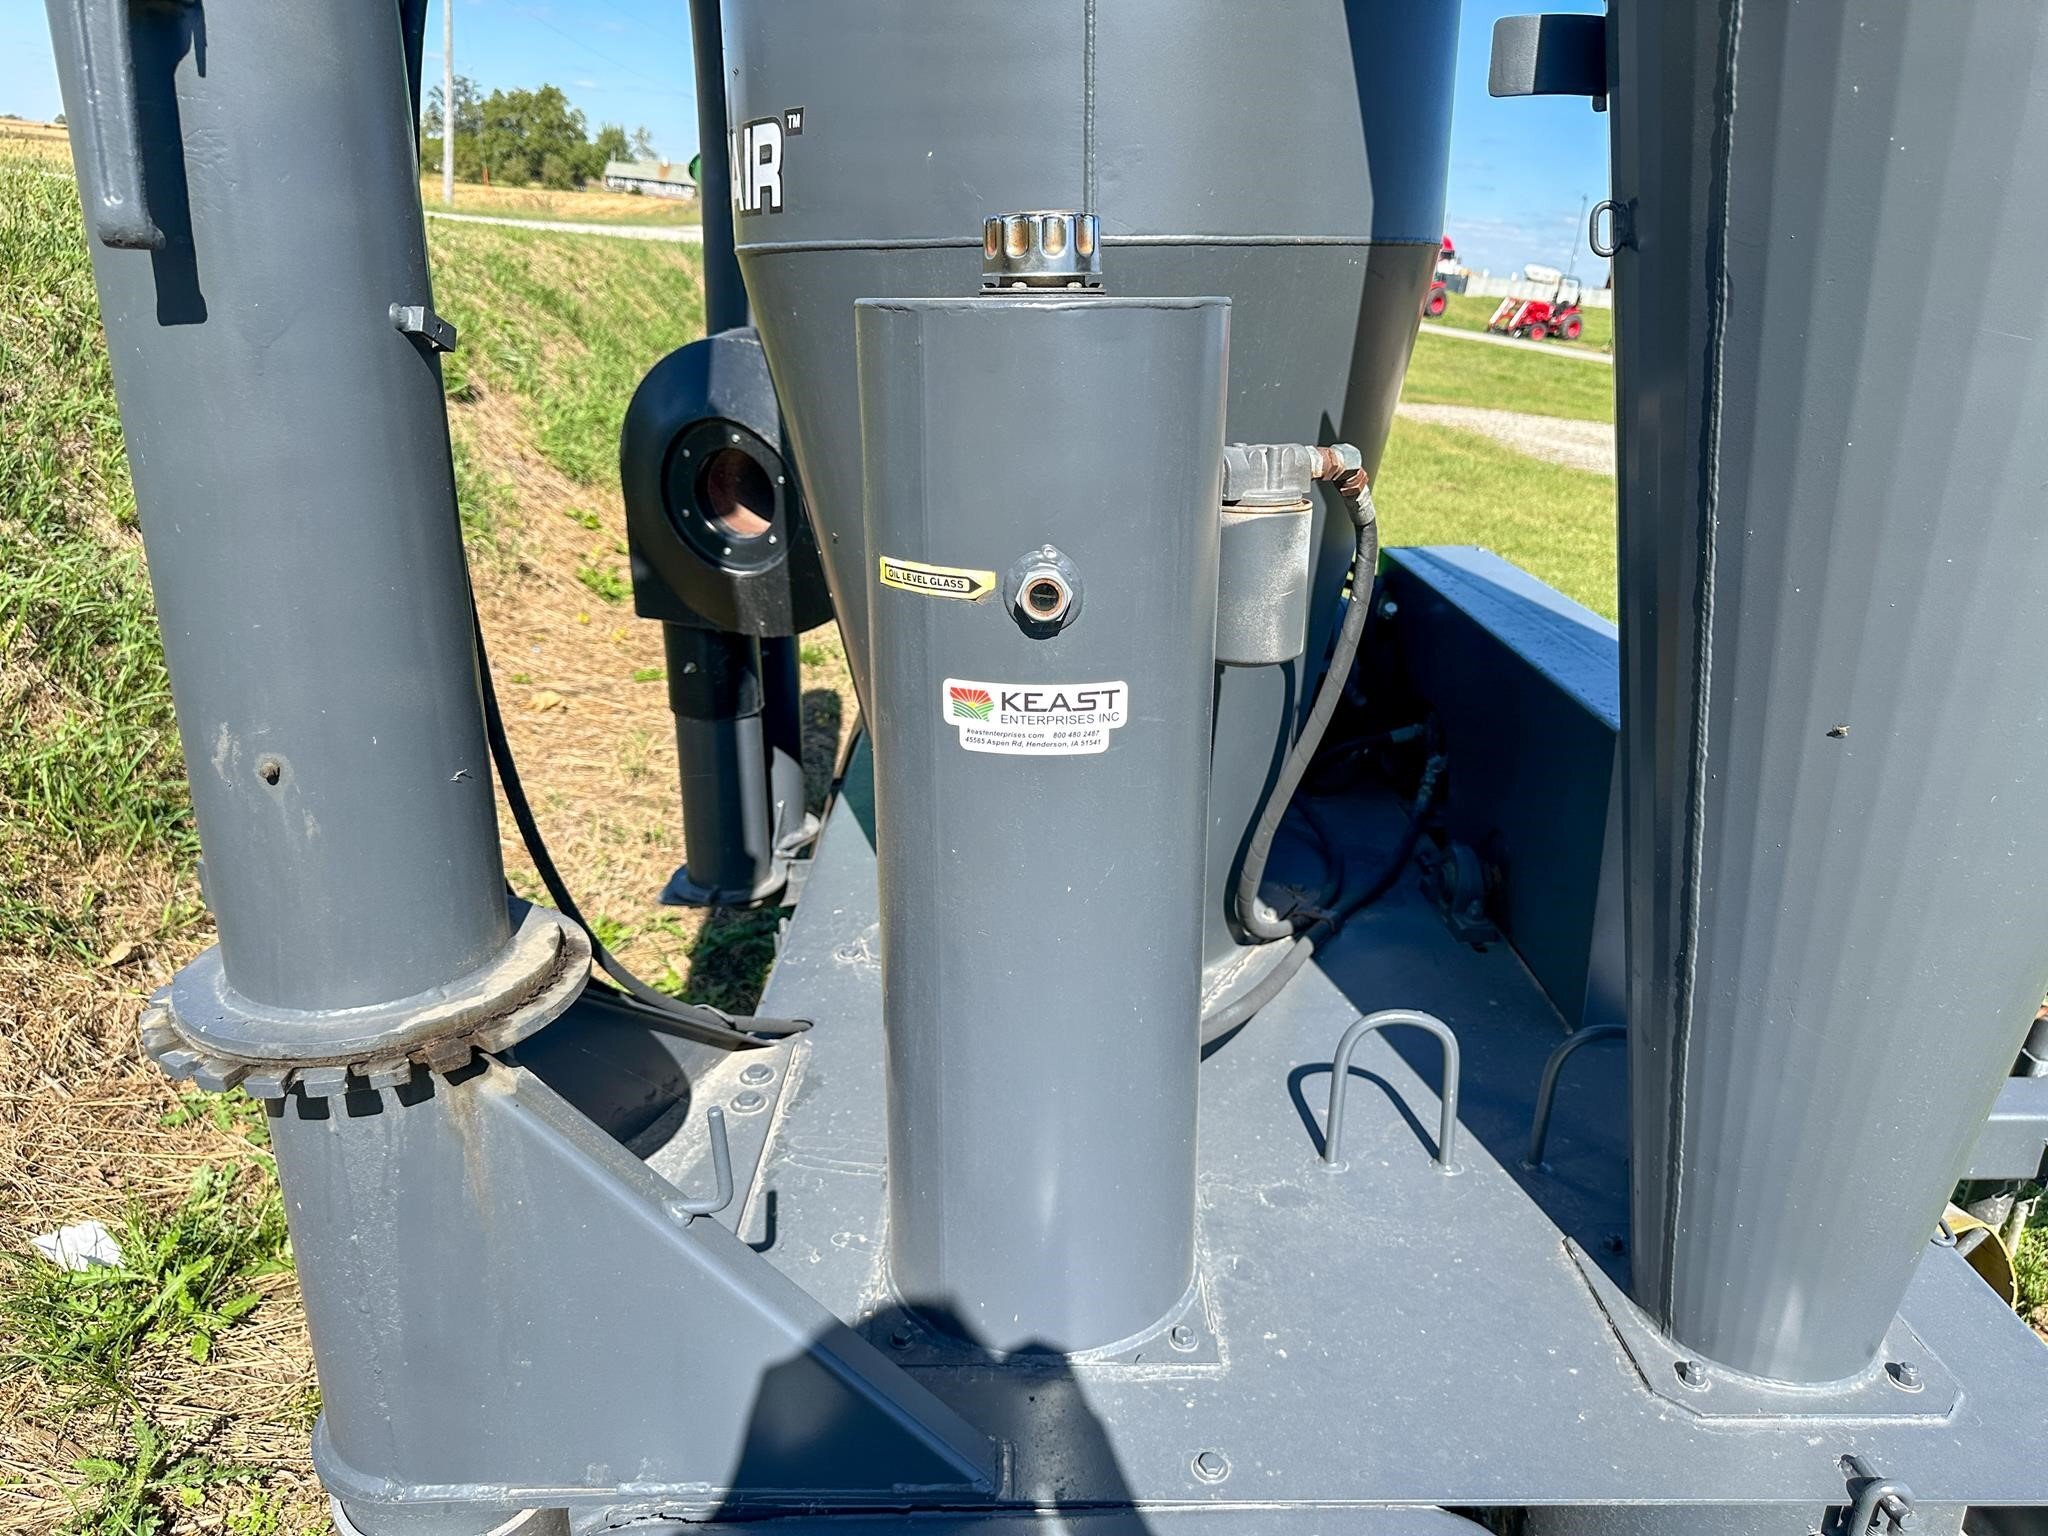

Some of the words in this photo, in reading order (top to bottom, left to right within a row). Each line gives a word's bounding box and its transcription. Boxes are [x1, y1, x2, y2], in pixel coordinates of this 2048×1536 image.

[888, 568, 900, 579] OIL
[902, 571, 928, 585] LEVEL
[930, 577, 964, 589] GLASS
[1001, 689, 1121, 713] KEAST
[1000, 713, 1095, 726] ENTERPRISES
[1098, 711, 1120, 723] INC
[966, 728, 1045, 739] keastenterprisescom
[987, 739, 1009, 747] Aspen
